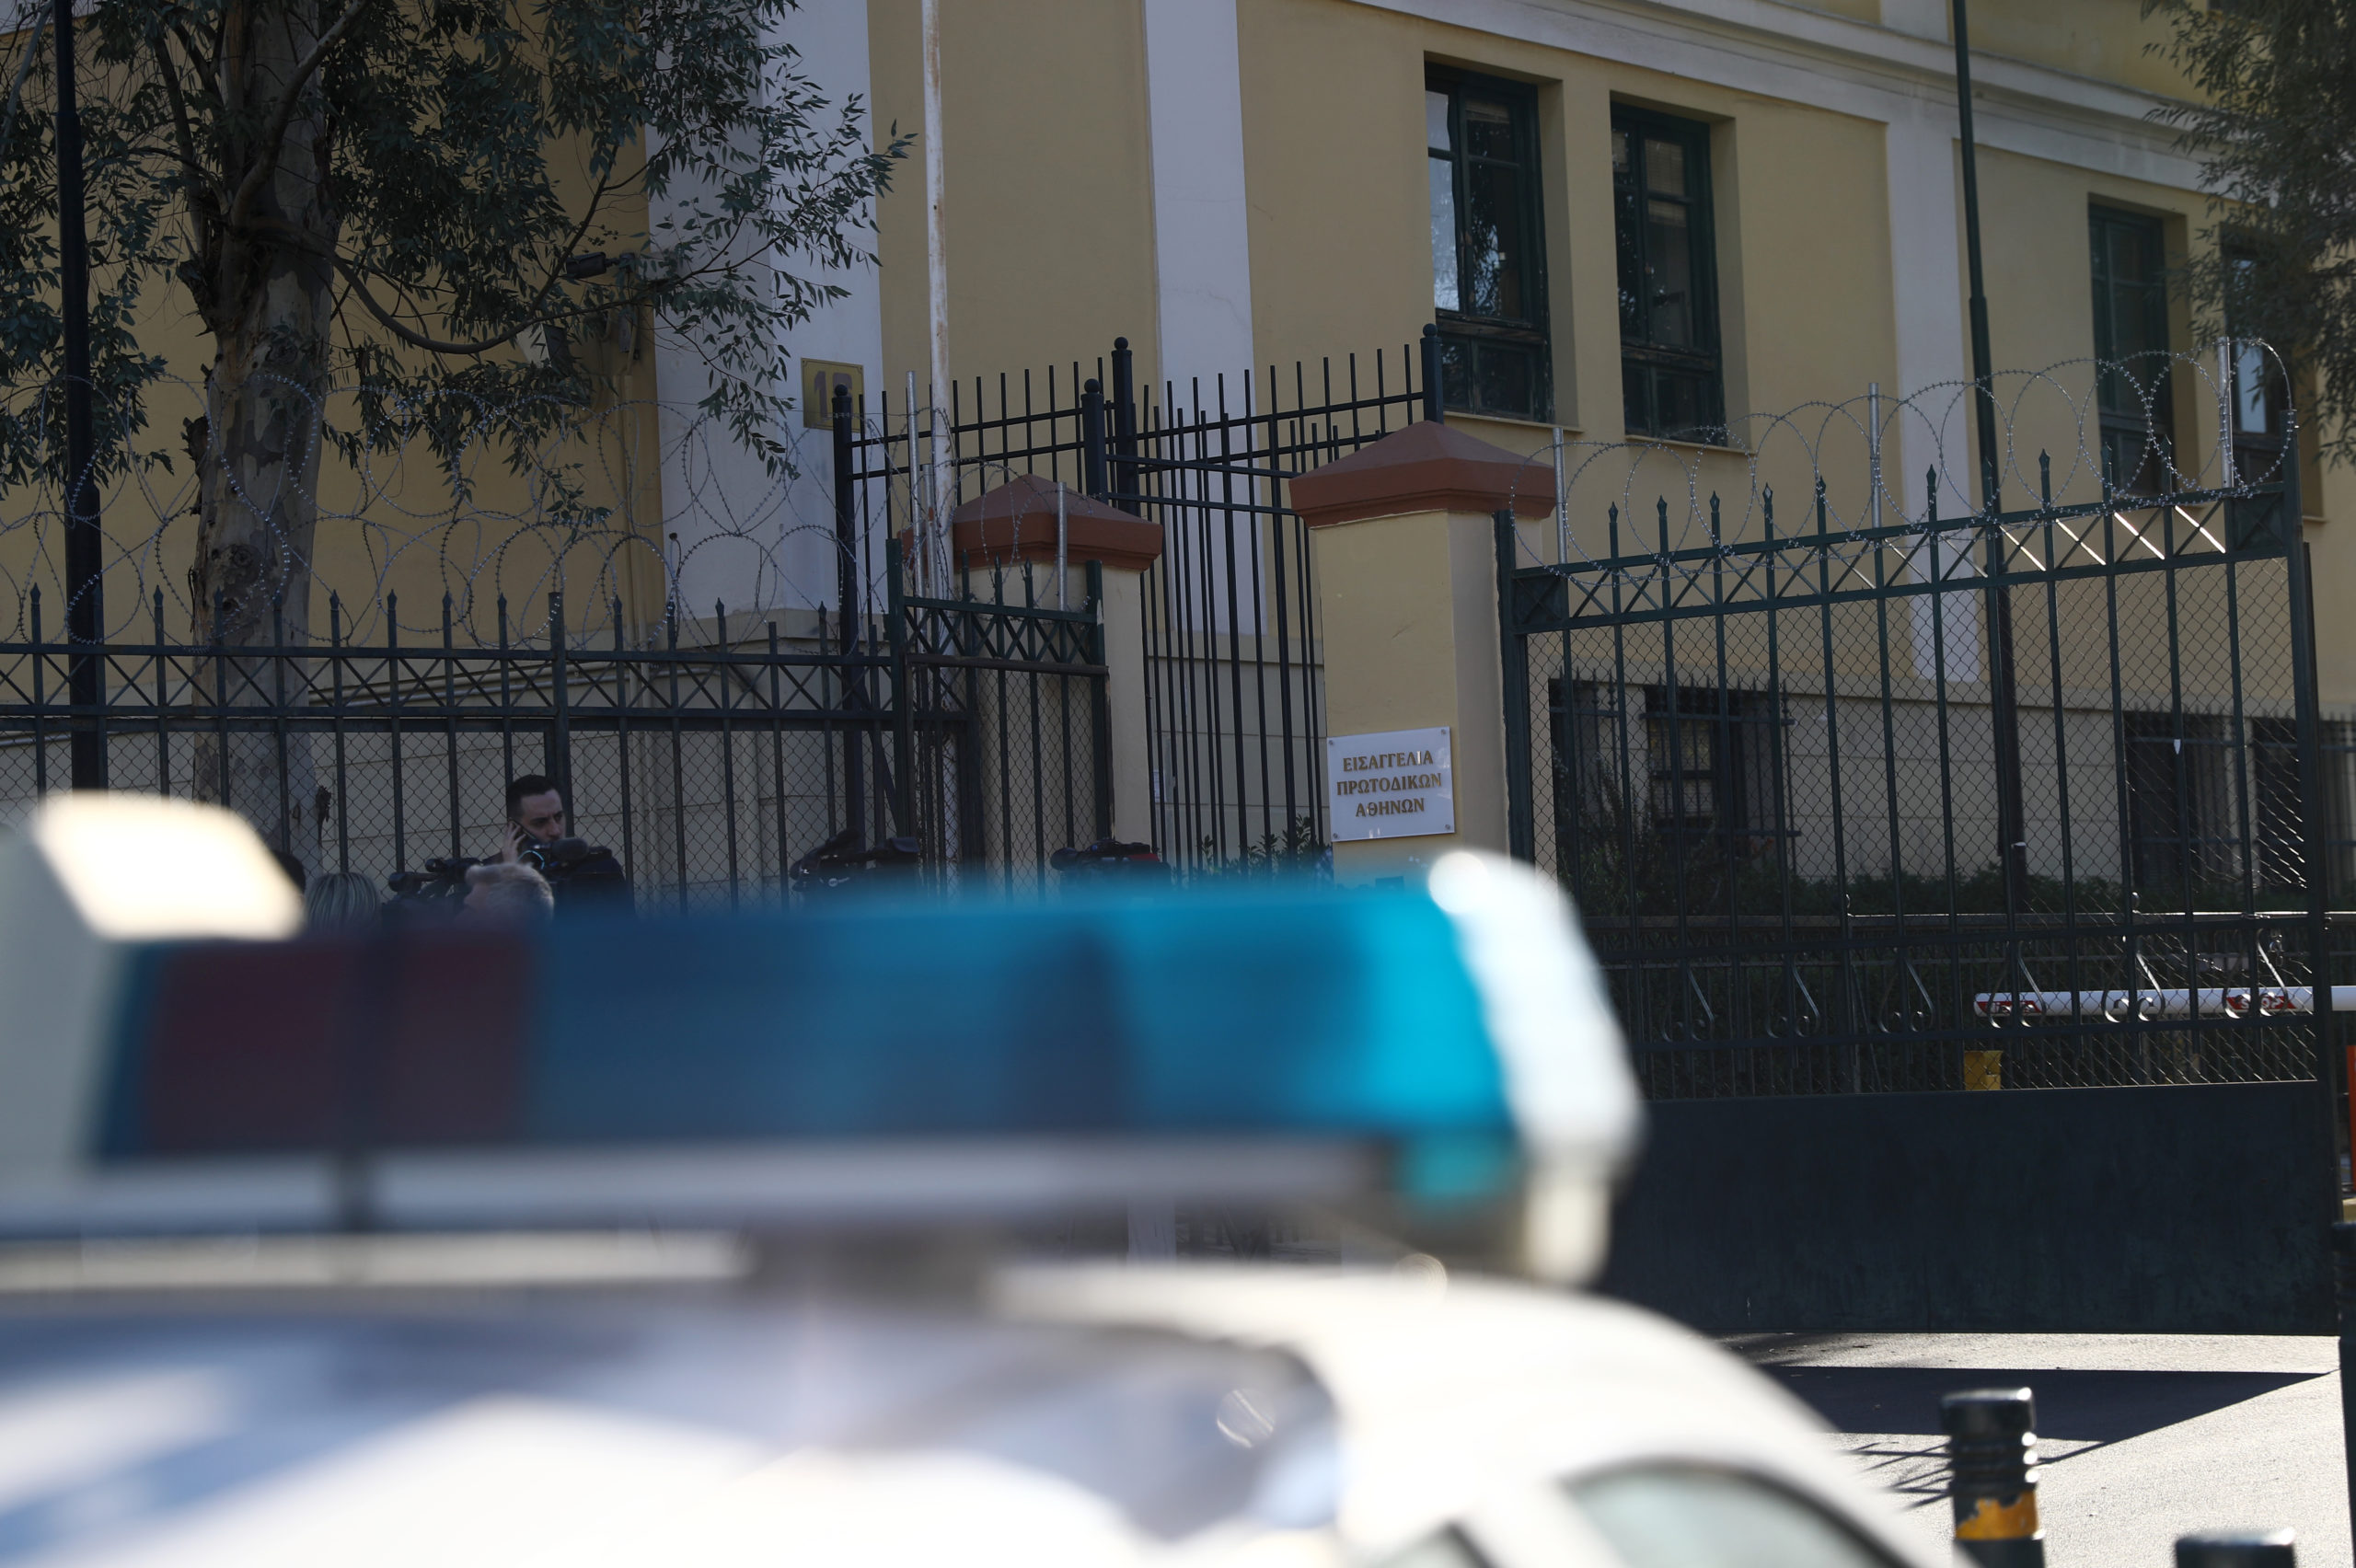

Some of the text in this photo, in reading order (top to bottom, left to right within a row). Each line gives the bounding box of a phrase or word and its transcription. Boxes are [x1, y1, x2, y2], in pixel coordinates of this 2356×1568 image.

[1343, 750, 1433, 772] ΕΙΣΑΓΓΕΛΙΑ
[1336, 773, 1442, 796] ΠΡΩΤΟΔΙΚΩΝ
[1355, 798, 1425, 817] ΑΘΗΝΩΝ
[2241, 997, 2281, 1009] SOP
